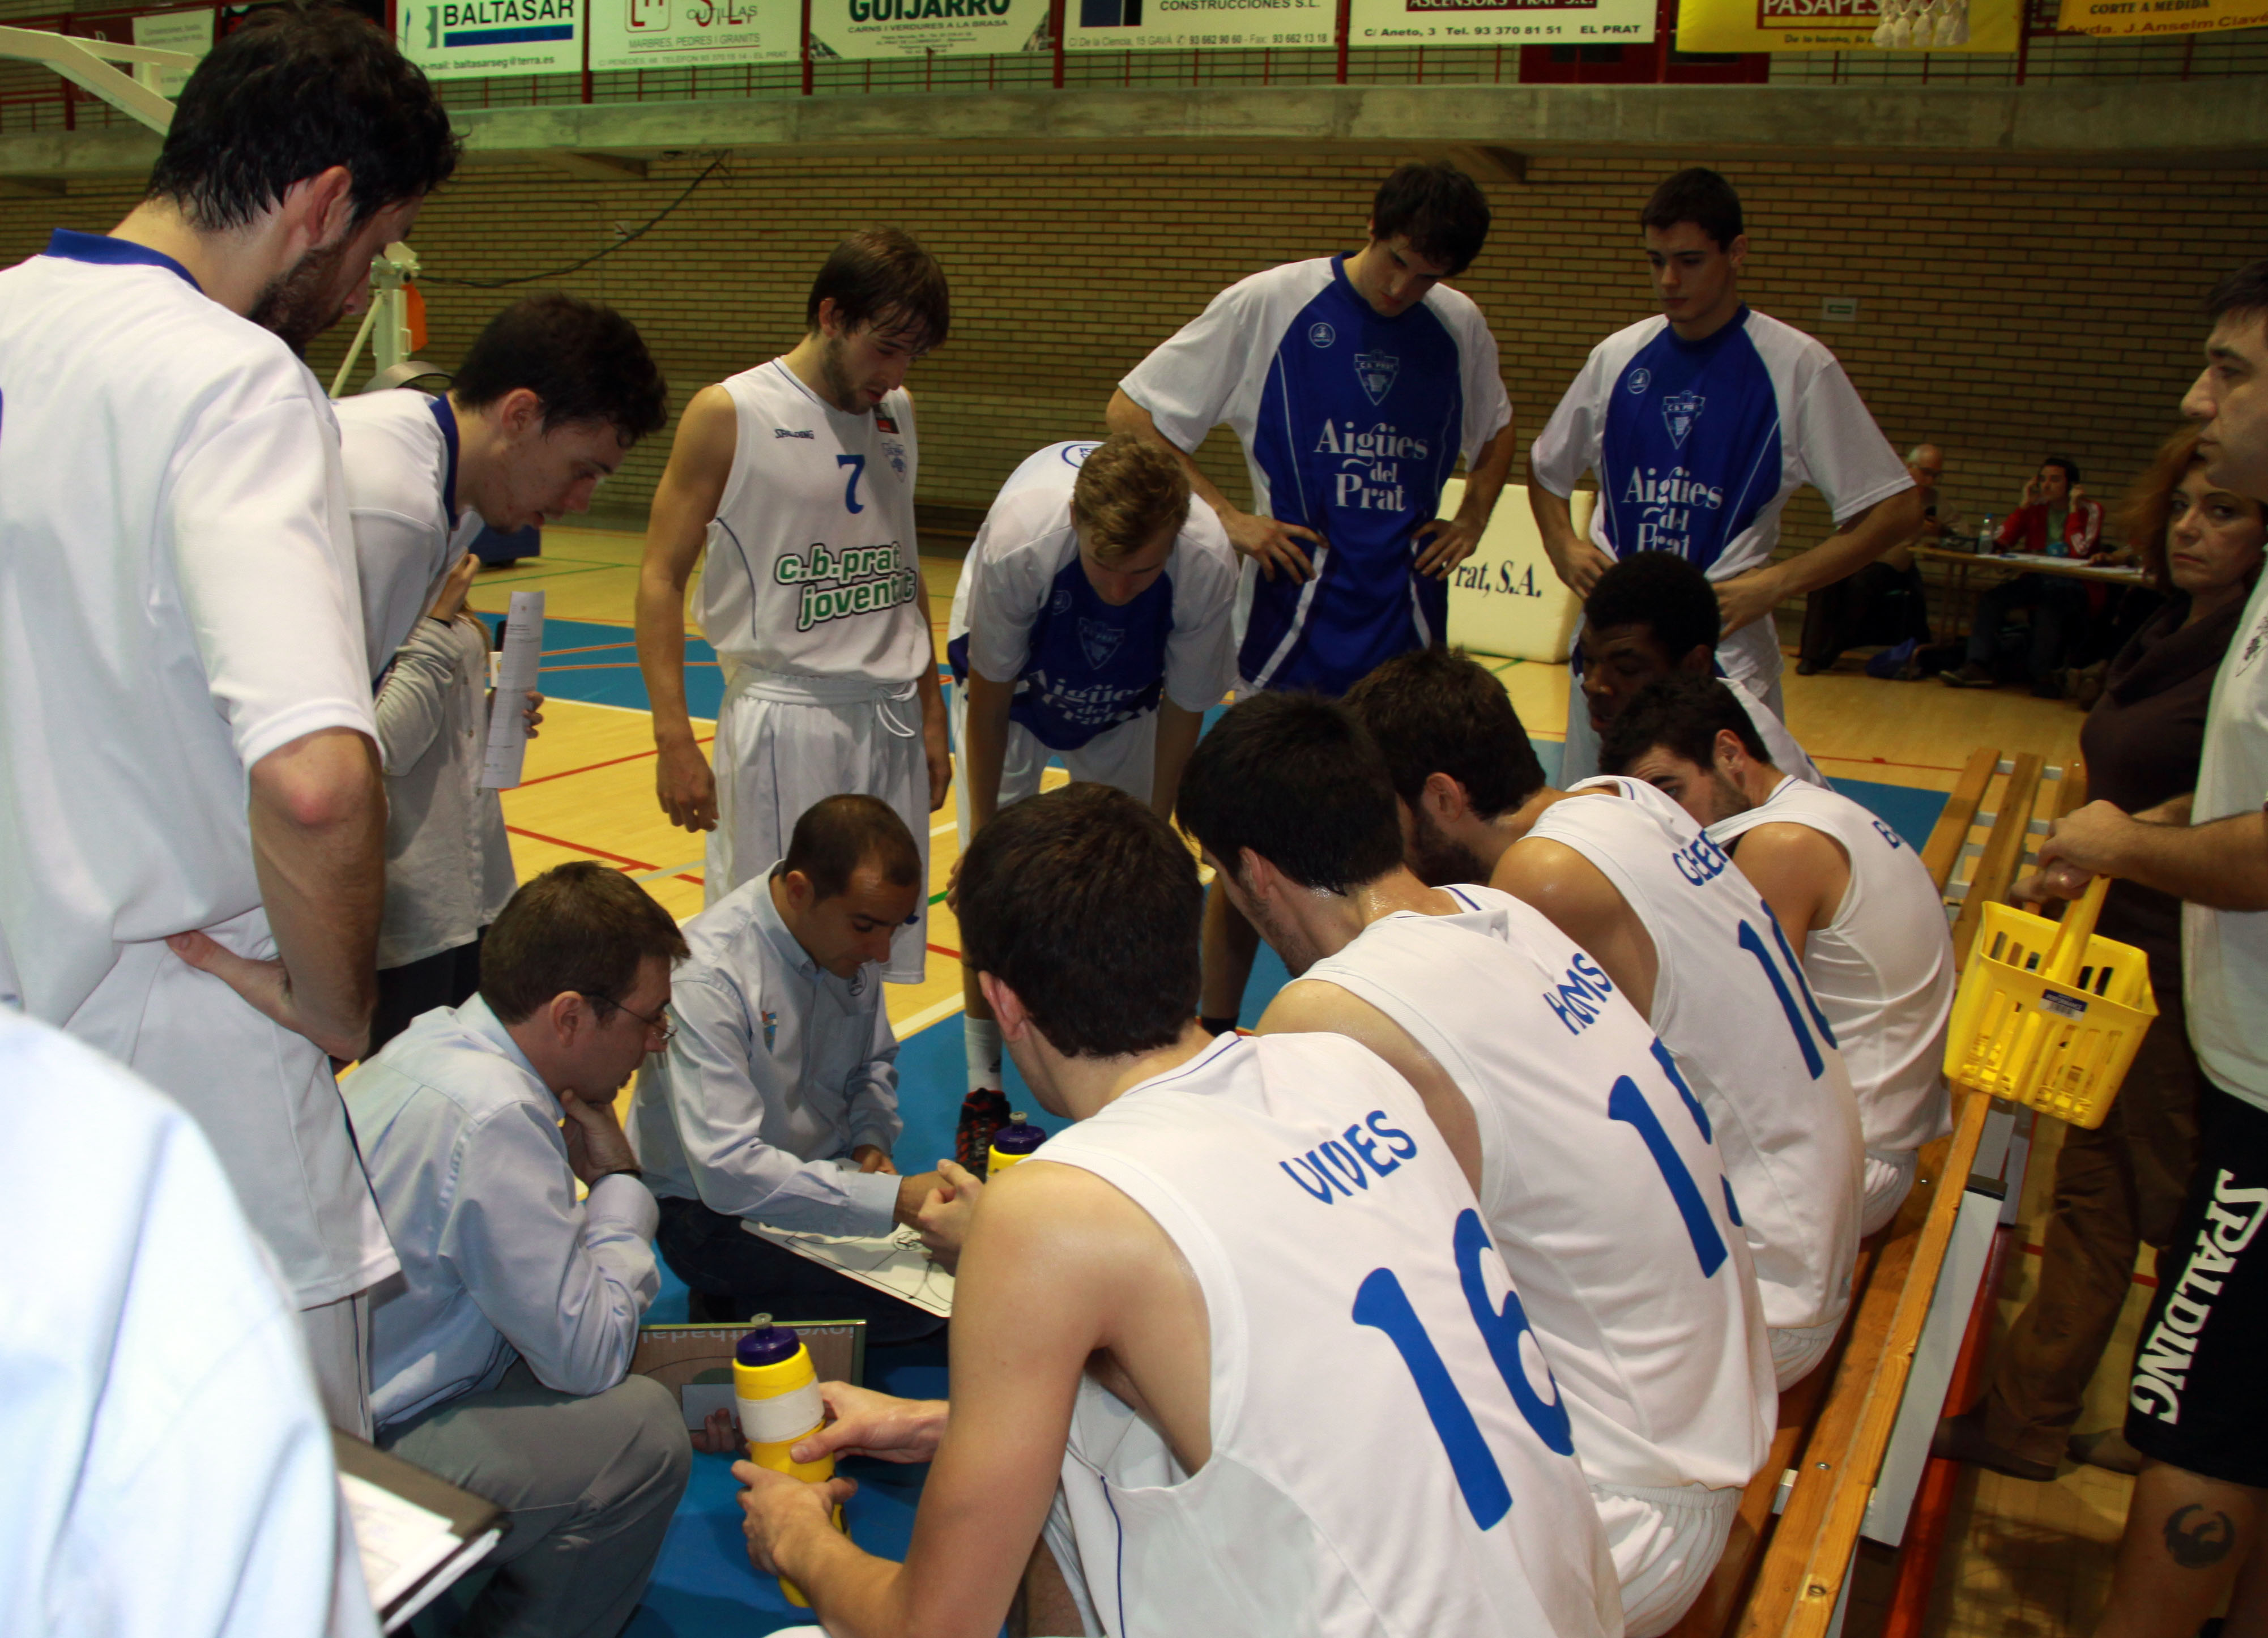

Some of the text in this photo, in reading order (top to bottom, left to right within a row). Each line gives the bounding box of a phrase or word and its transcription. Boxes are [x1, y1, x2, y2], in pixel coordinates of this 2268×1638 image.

[444, 0, 573, 26] BALTASAR
[849, 0, 1011, 22] GUIJARRO
[1160, 0, 1291, 11] CONSTRUCCIONES
[2090, 0, 2211, 14] CORTE A MEDIDA
[890, 23, 944, 31] VERDURES
[1364, 28, 1375, 36] C/
[1381, 28, 1423, 37] Aneto,
[1446, 27, 1469, 35] Tel.
[1546, 25, 1562, 34] 51
[1602, 25, 1640, 33] PRAT
[1312, 418, 1428, 470] Aigües
[836, 454, 866, 514] 7
[1370, 462, 1397, 483] del
[1334, 474, 1406, 511] Prat
[1621, 466, 1724, 518] Aigües
[1495, 560, 1542, 598] S.A.
[1278, 1110, 1417, 1205] VIDES
[2130, 1168, 2268, 1424] SPALDING
[1352, 1208, 1575, 1532] 16
